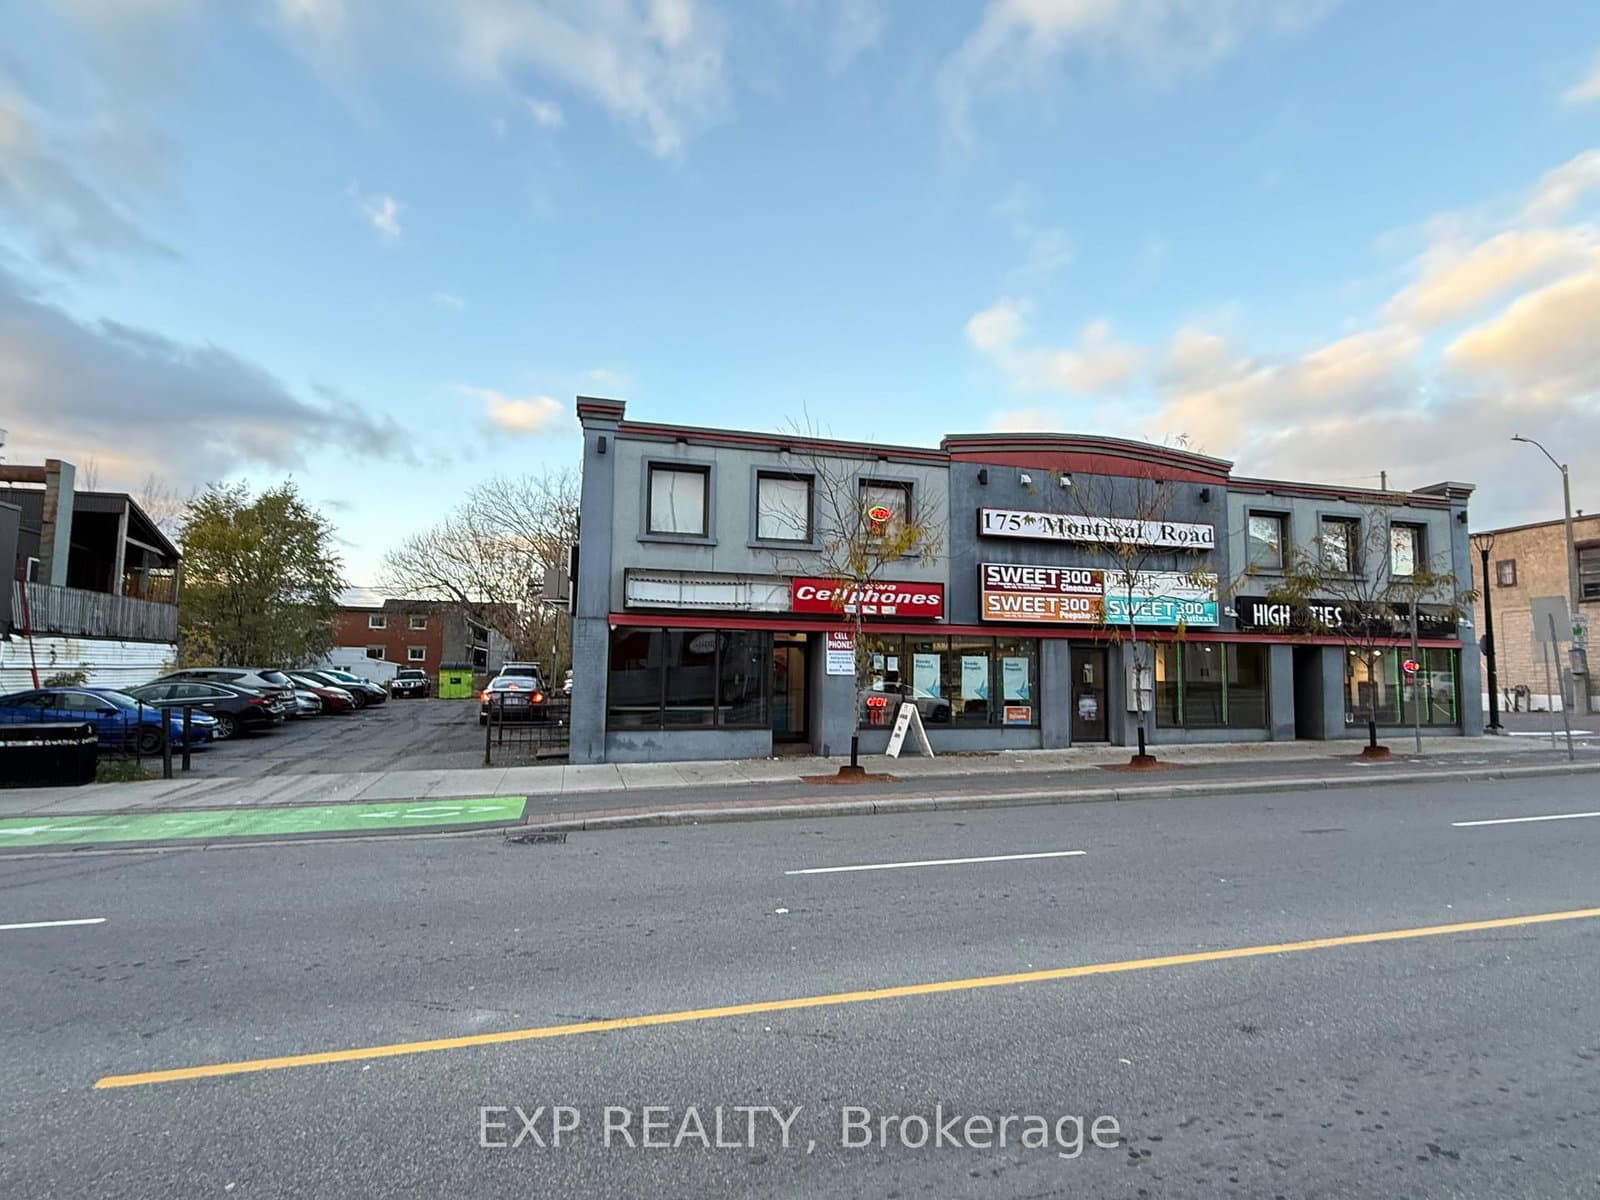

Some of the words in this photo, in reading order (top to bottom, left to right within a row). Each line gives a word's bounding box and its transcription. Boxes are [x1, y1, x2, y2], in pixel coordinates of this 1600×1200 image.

[984, 512, 1021, 531] 175
[1161, 524, 1213, 543] Road
[987, 566, 1059, 585] SWEET
[1060, 570, 1091, 584] 300
[988, 595, 1059, 613] SWEET
[1060, 598, 1090, 612] 300
[1109, 600, 1174, 617] SWEET
[1175, 602, 1203, 615] 300
[1253, 603, 1290, 627] HIGH
[834, 632, 848, 640] CELL
